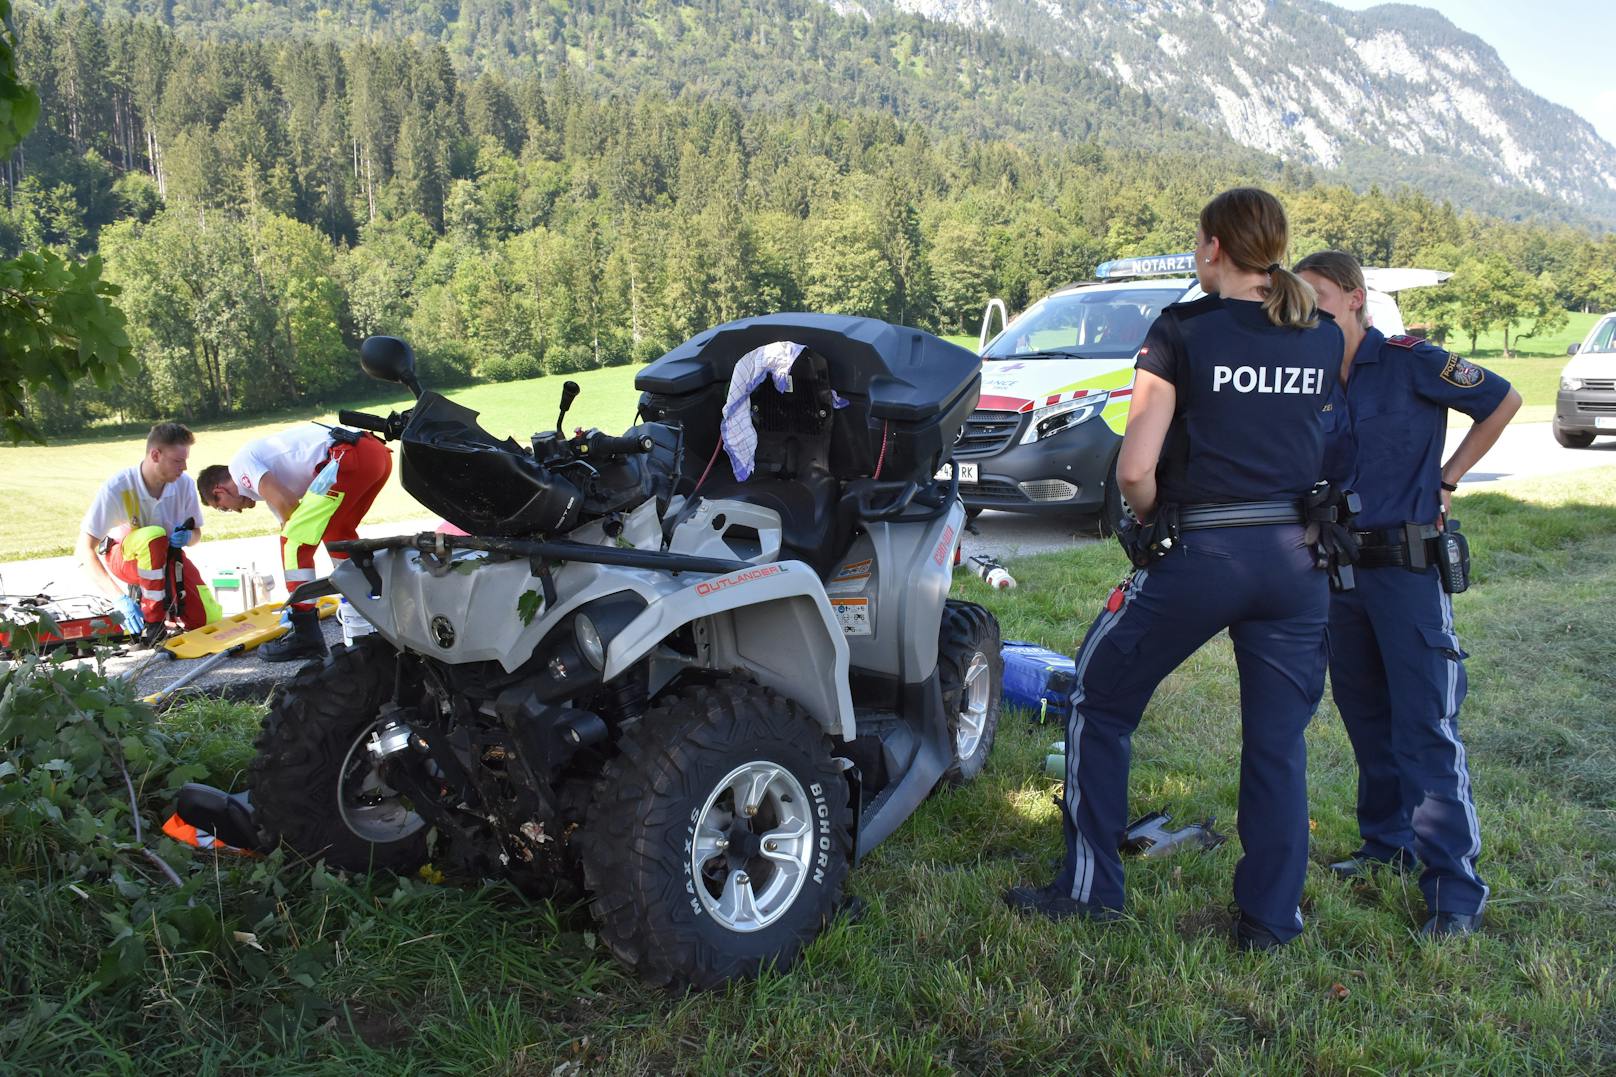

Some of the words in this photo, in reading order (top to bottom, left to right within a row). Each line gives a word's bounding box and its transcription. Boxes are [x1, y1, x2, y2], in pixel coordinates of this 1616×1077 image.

[1132, 256, 1195, 273] NOTARZT
[1213, 366, 1324, 394] POLIZEI
[961, 466, 973, 478] RK
[695, 566, 779, 597] OUTLANDER
[810, 783, 831, 885] BIGHORN
[684, 808, 702, 916] MAXXIS
